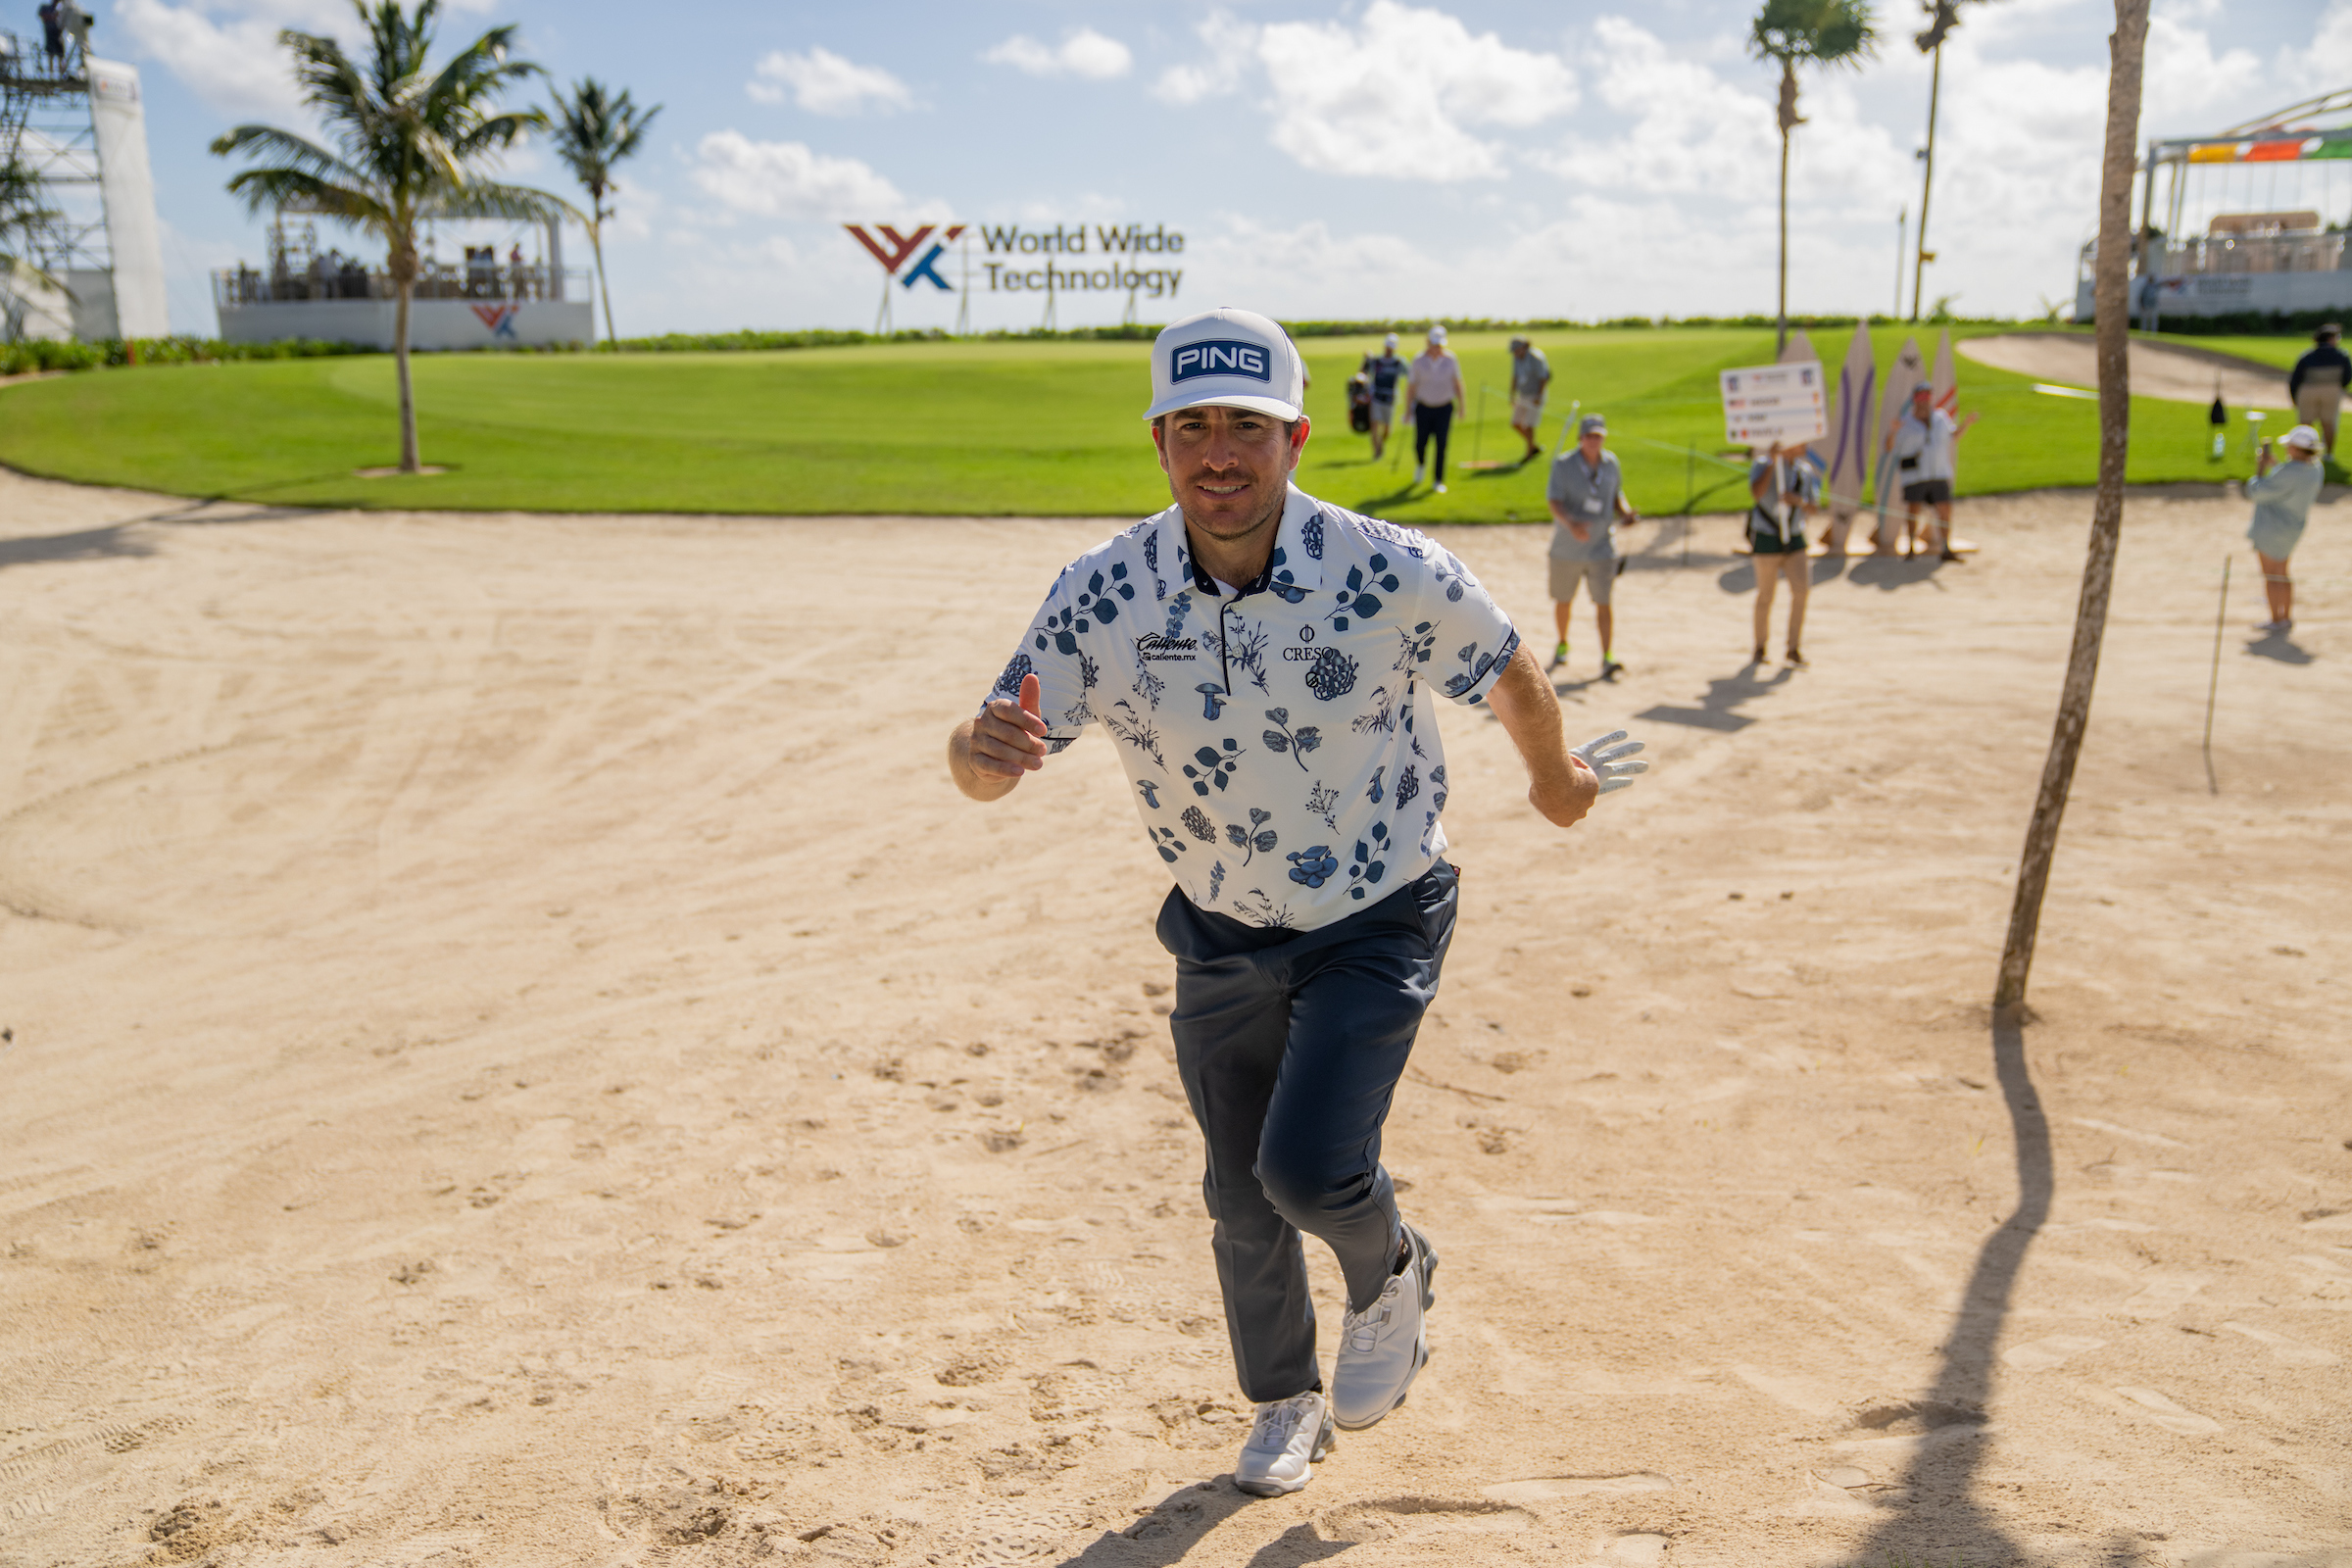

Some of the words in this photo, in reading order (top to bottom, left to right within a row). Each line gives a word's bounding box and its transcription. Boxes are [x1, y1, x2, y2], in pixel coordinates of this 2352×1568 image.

[981, 224, 1085, 253] World
[1098, 224, 1185, 253] Wide
[982, 262, 1182, 298] Technology
[1177, 346, 1263, 375] PING
[1136, 631, 1198, 652] Caliente
[1283, 647, 1333, 662] CRESO
